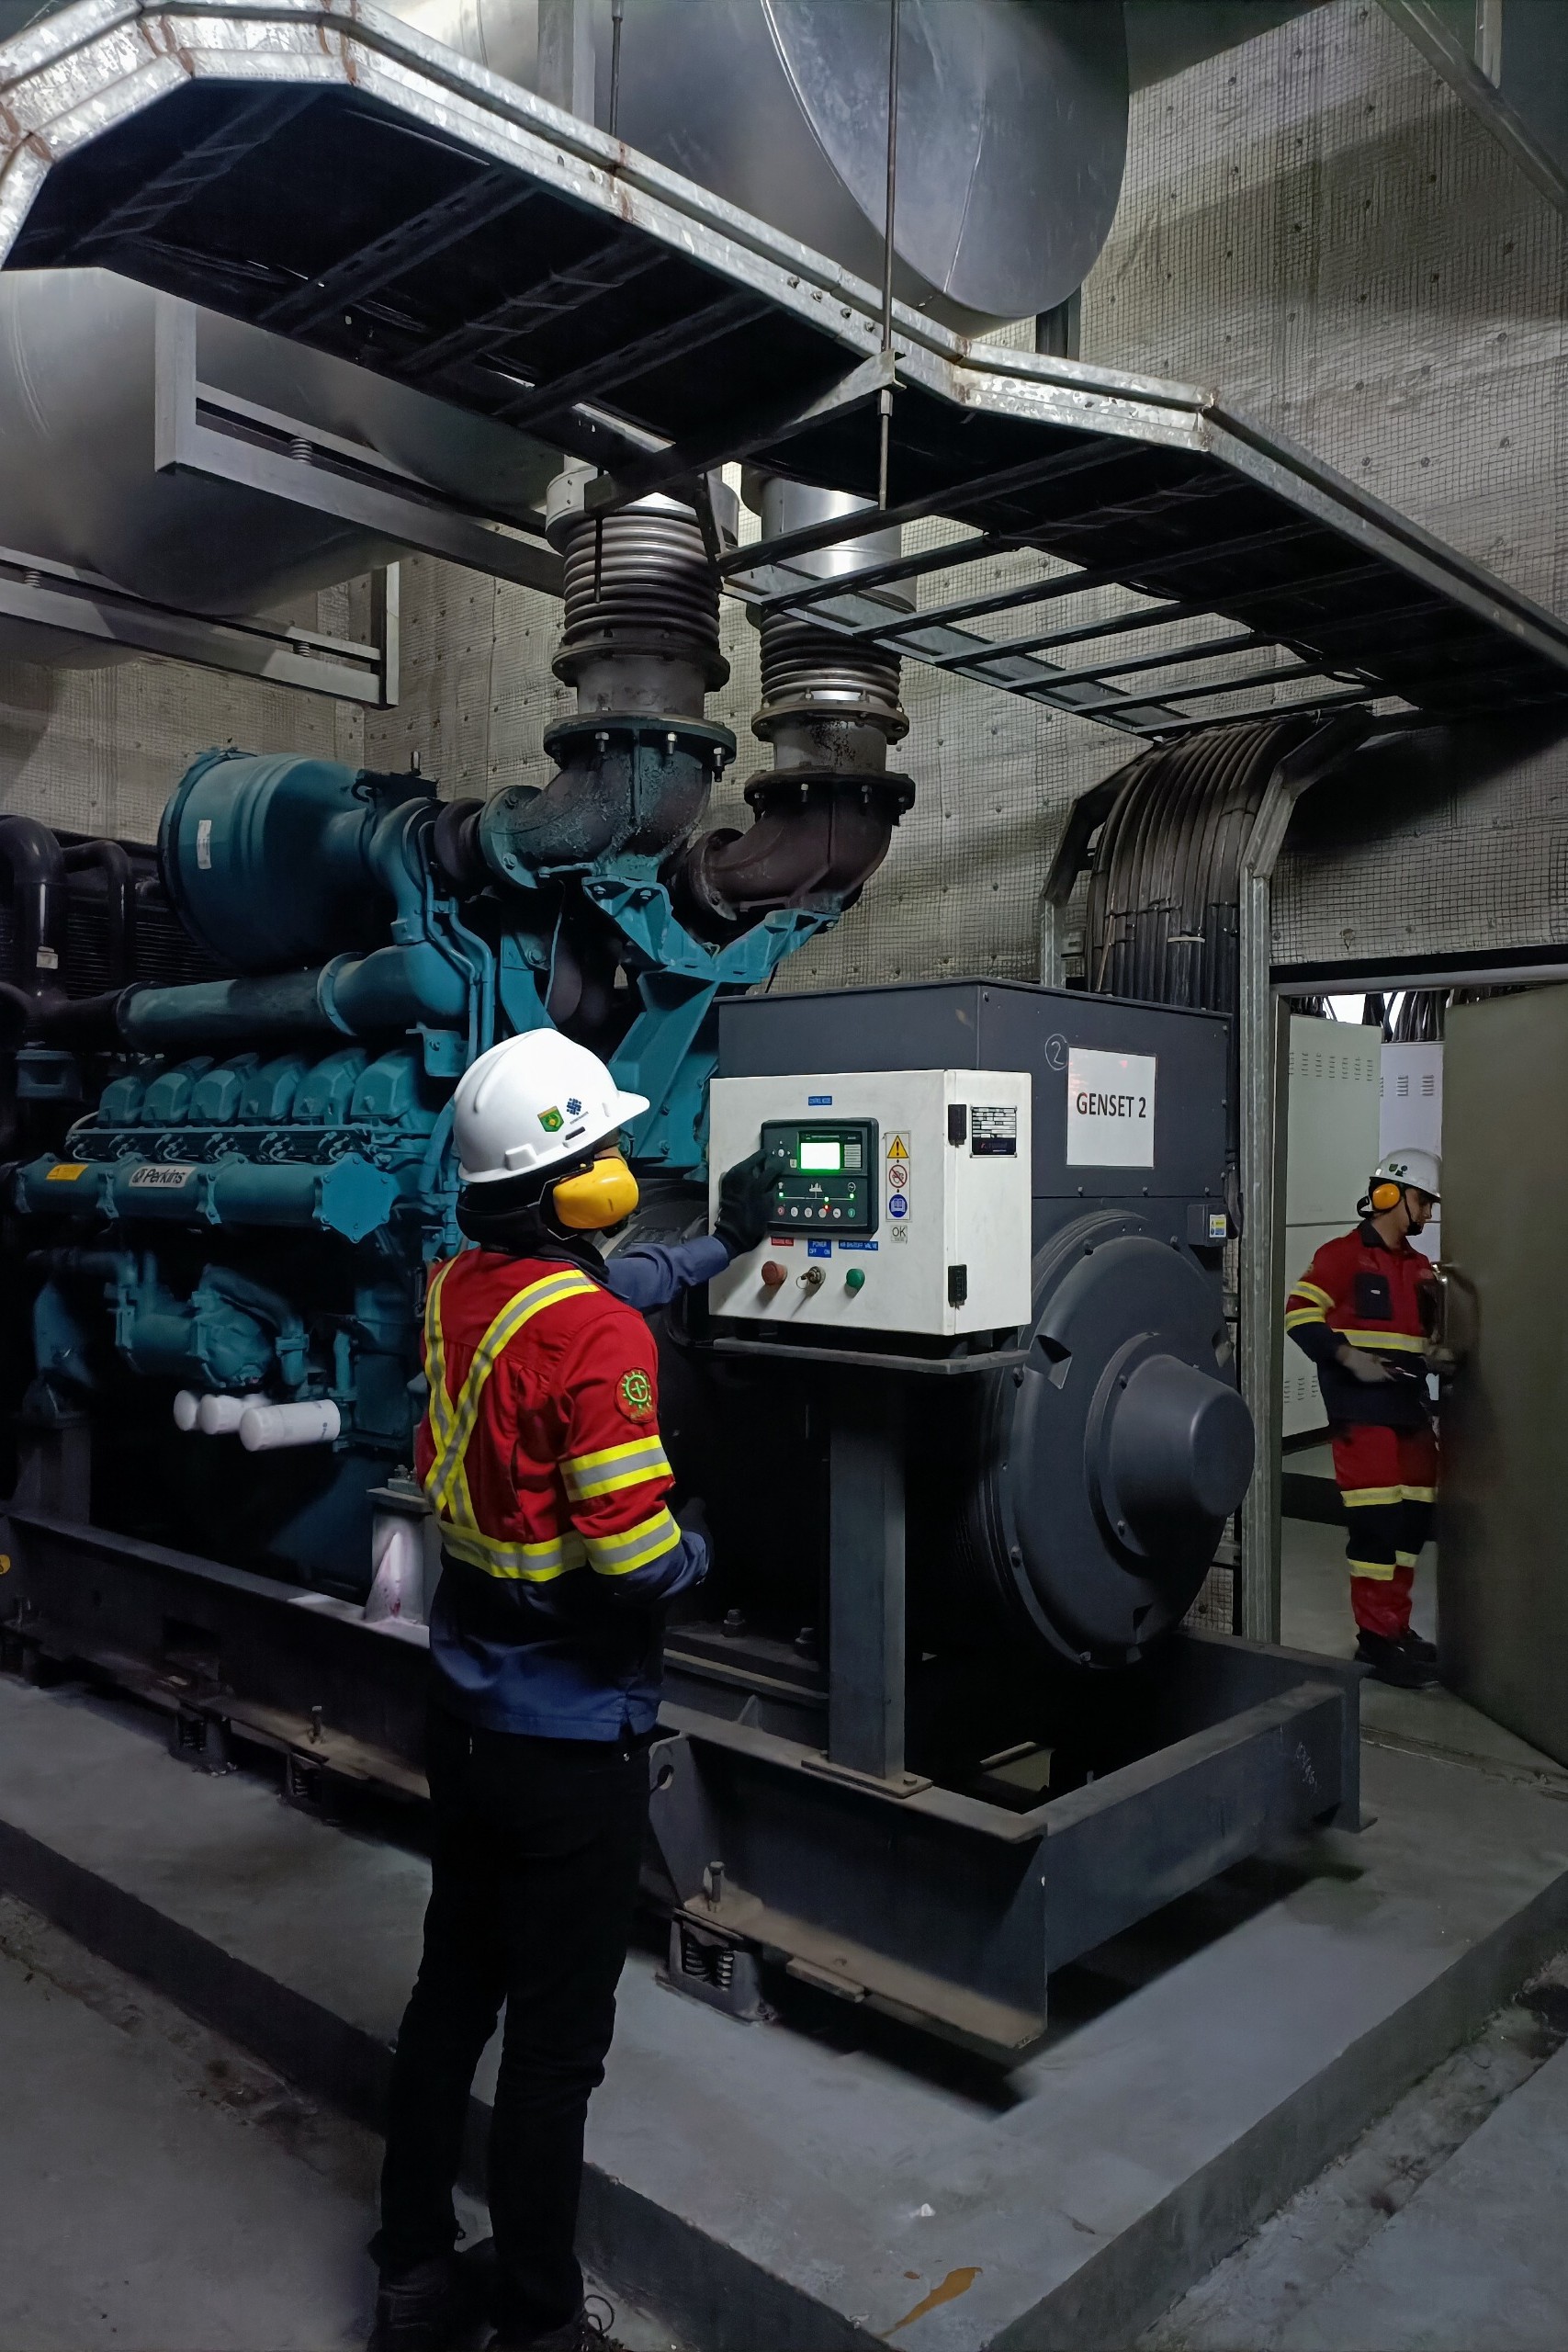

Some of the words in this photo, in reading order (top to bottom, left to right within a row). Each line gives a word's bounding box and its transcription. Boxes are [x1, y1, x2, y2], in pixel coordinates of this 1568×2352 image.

[1051, 1040, 1065, 1065] 2
[1076, 1091, 1134, 1117] GENSET
[1138, 1096, 1146, 1118] 2
[144, 1168, 186, 1184] Perkins
[892, 1227, 907, 1237] OK
